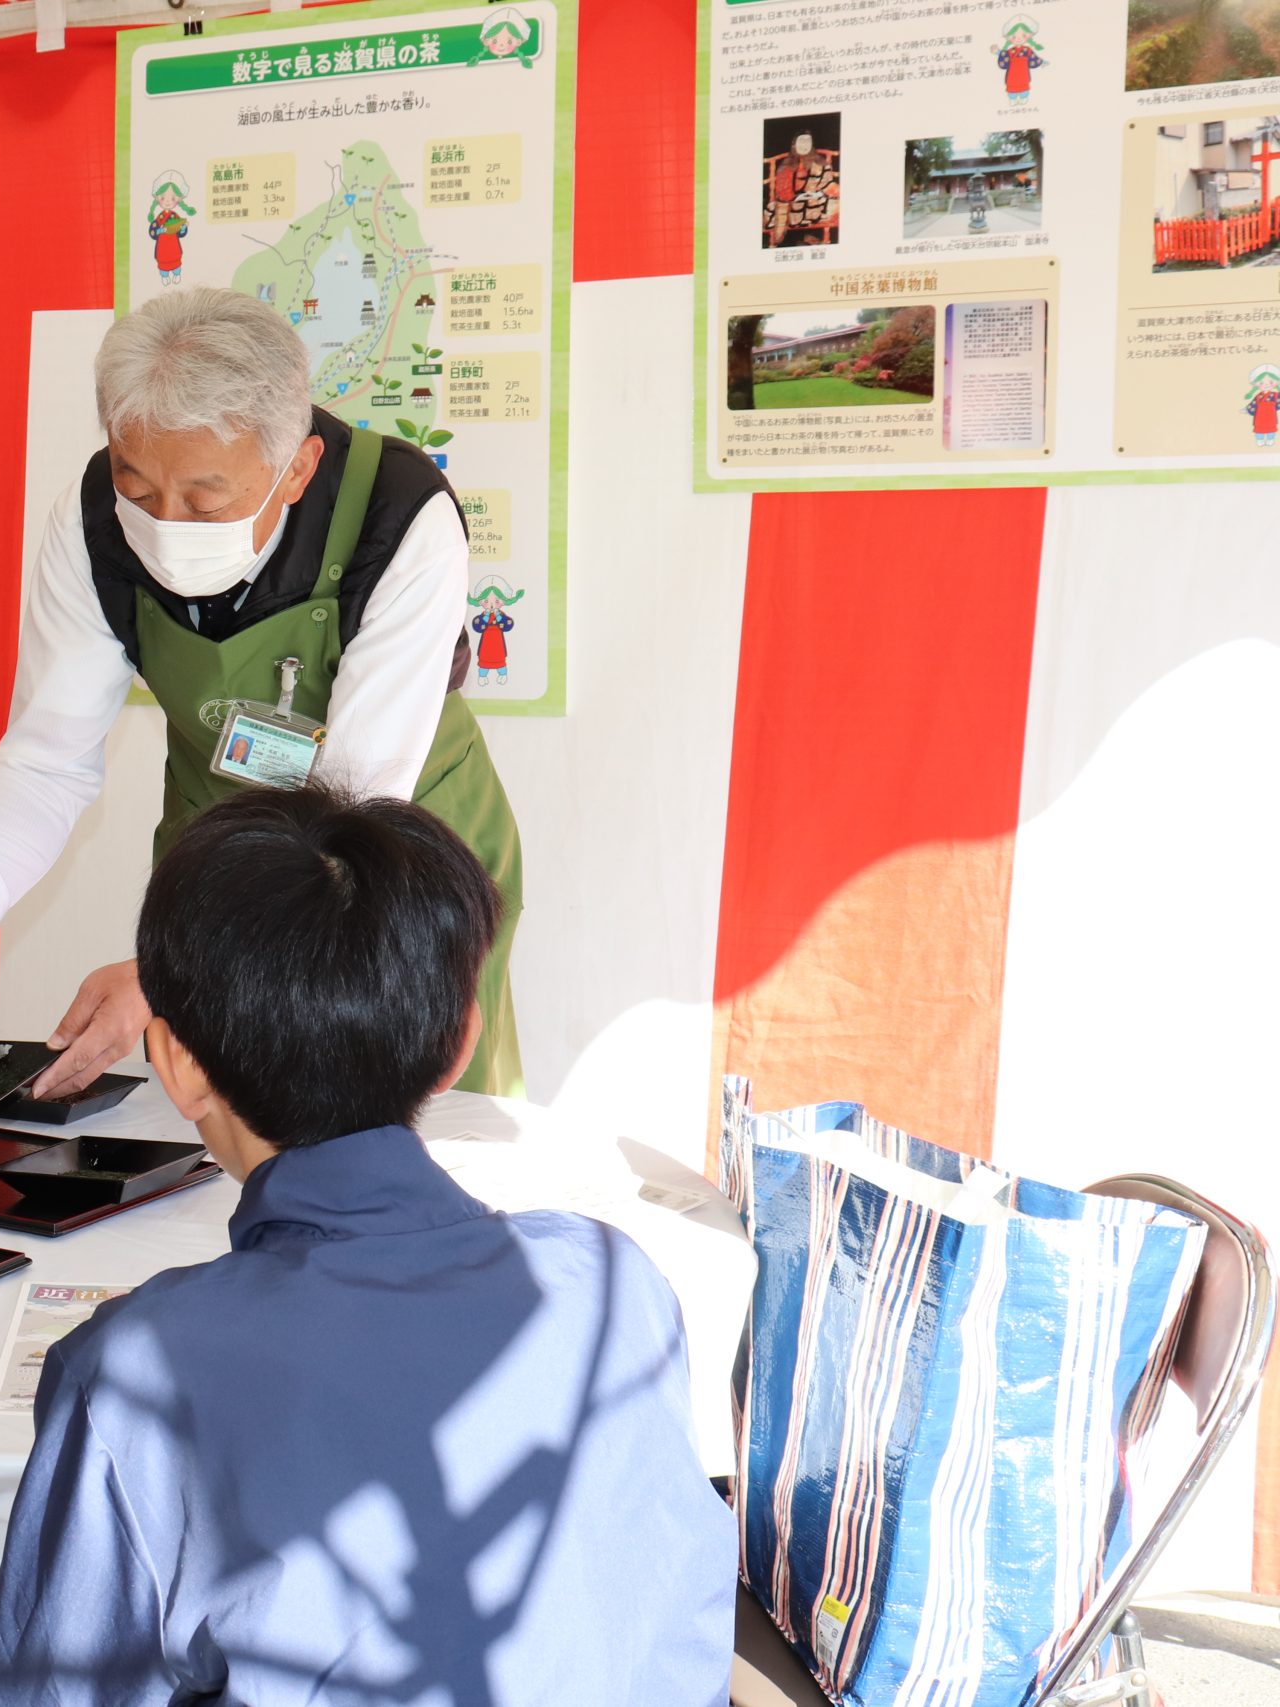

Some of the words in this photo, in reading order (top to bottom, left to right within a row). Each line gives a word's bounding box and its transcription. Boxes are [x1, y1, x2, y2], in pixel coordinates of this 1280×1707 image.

[232, 41, 440, 84] 数字で見る滋賀県の茶
[237, 97, 431, 127] 湖国の風土が生み出した豊かな香り。
[431, 150, 465, 164] 長浜市
[486, 162, 501, 173] 2戸
[212, 168, 244, 182] 高島市
[263, 180, 282, 190] 44戸
[430, 178, 462, 189] 栽培面積
[485, 176, 510, 187] 6.1ha
[212, 196, 242, 206] 栽培面積
[263, 193, 286, 203] 3.3ha
[485, 189, 504, 200] 0.7t
[263, 206, 280, 216] 1.9t
[450, 279, 497, 292] 東近江市
[830, 276, 938, 297] 中国茶葉博物館
[503, 293, 524, 302] 40戸
[450, 308, 483, 318] 栽培面積
[503, 306, 534, 316] 15.6ha
[503, 320, 522, 330] 5.3t
[450, 366, 484, 379] 日野町
[449, 382, 490, 391] 販売農家数
[505, 381, 520, 390] 2戸
[449, 395, 482, 405] 栽培面積
[505, 394, 530, 403] 7.2ha
[449, 408, 490, 418] 荒茶生産量
[505, 407, 530, 417] 21.1t
[468, 532, 503, 541] 96.8ha
